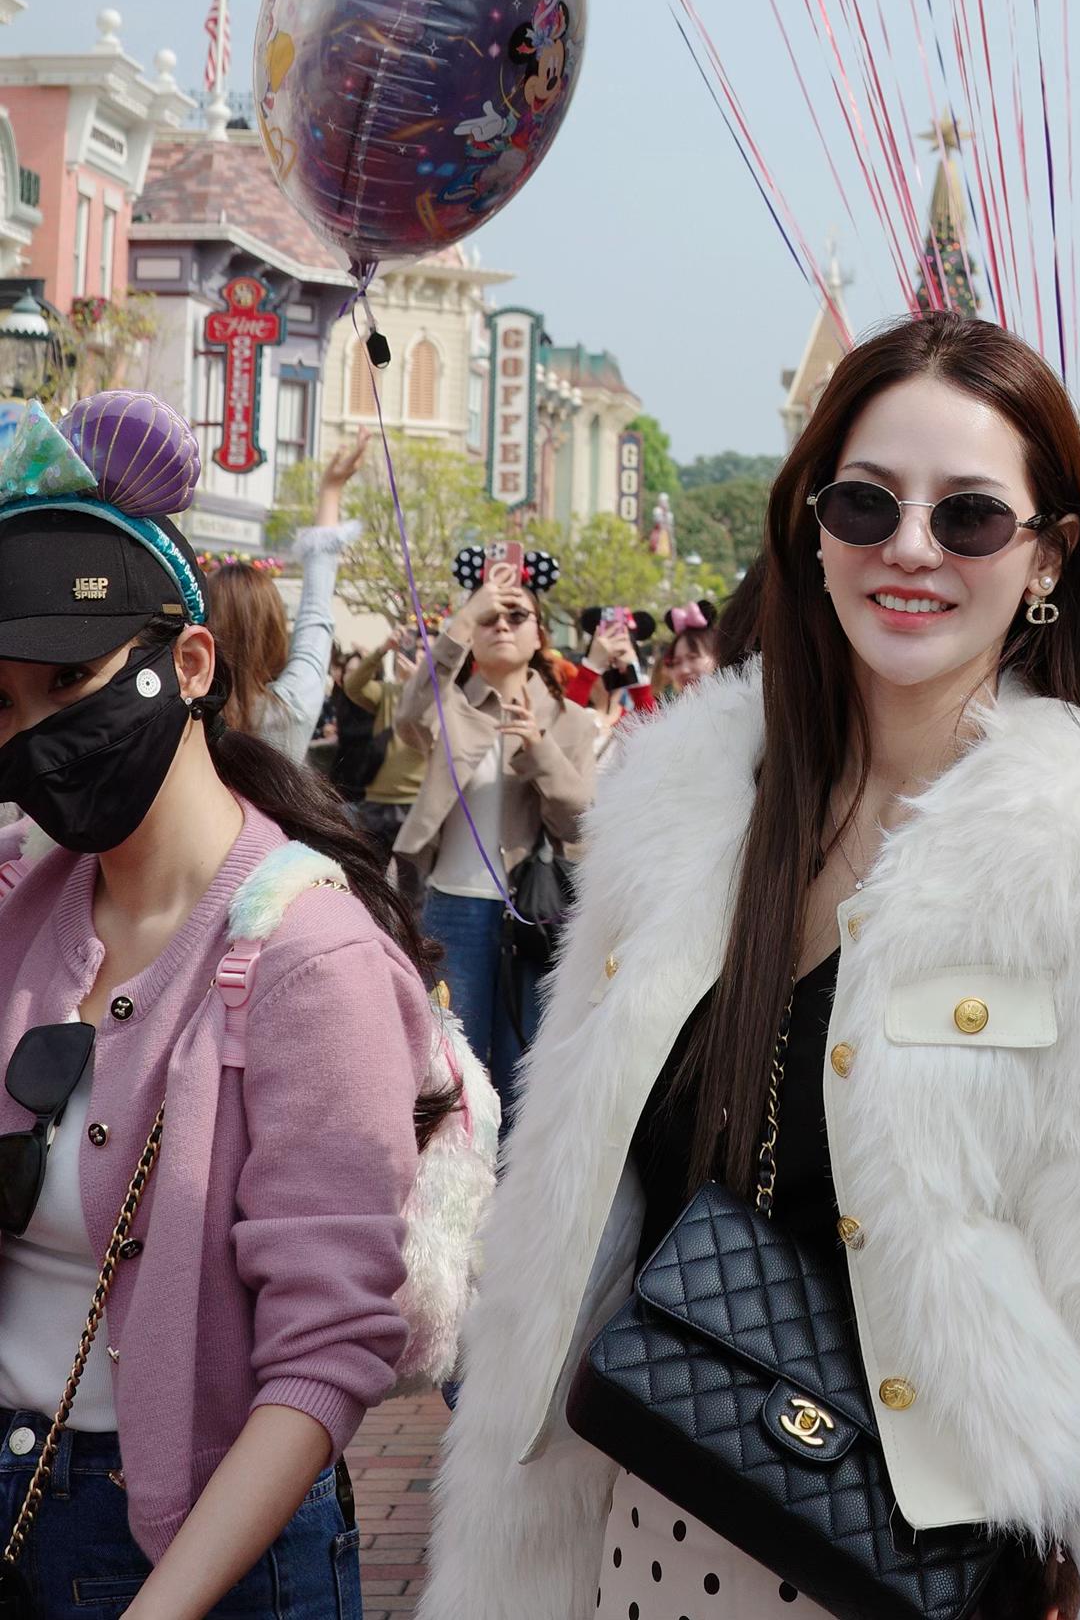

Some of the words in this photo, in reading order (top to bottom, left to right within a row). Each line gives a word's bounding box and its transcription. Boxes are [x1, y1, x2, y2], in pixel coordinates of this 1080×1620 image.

[499, 328, 525, 494] COFFEE
[620, 442, 639, 523] GOO
[72, 577, 109, 592] JEEP
[74, 589, 108, 600] SPIRIT
